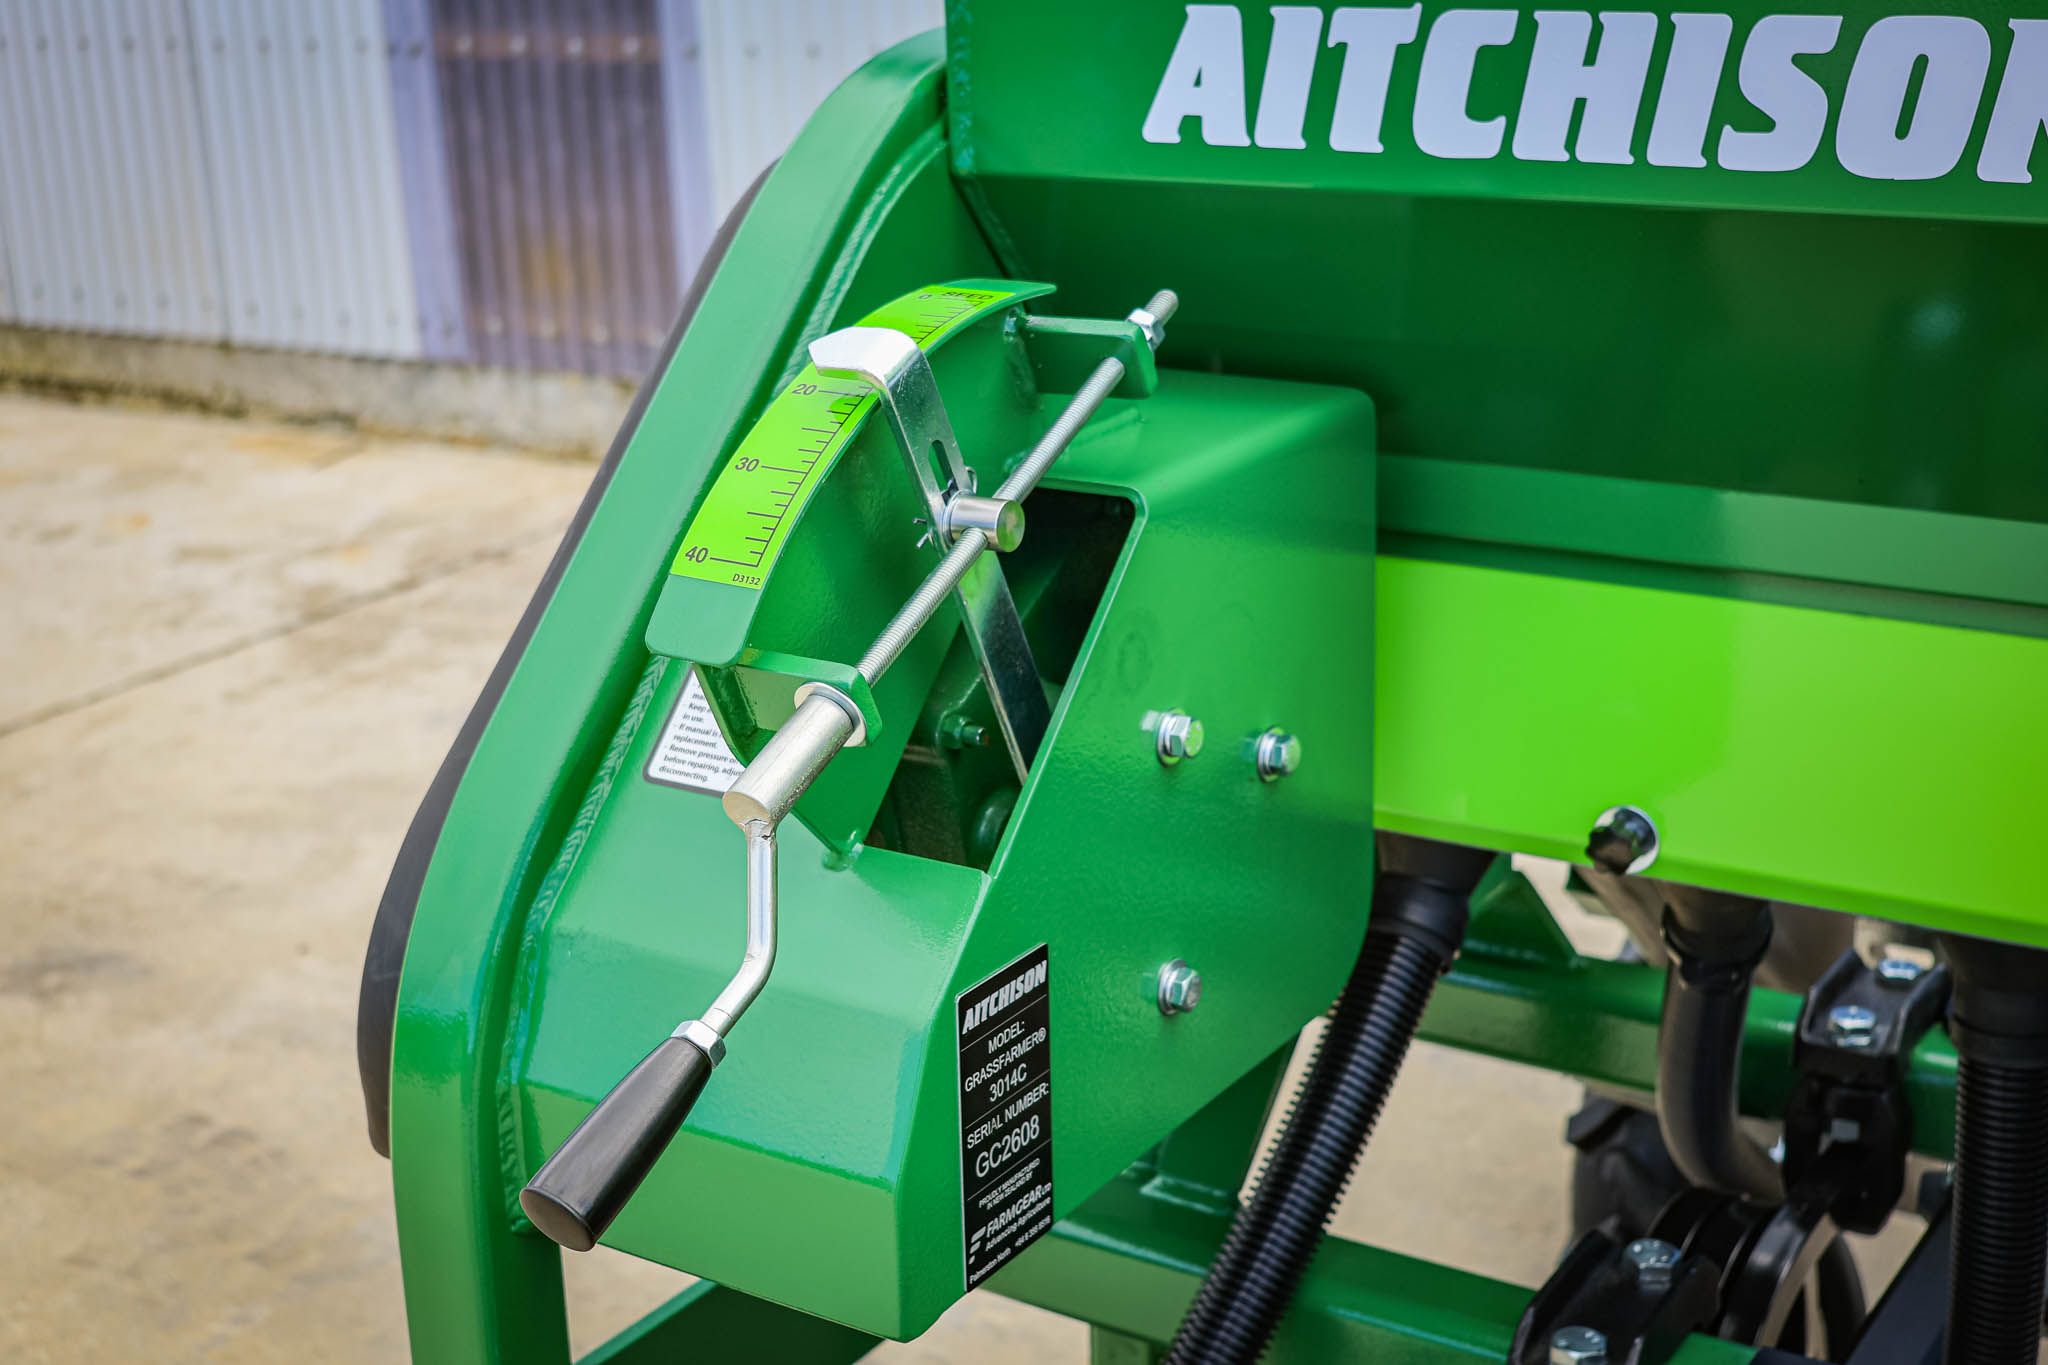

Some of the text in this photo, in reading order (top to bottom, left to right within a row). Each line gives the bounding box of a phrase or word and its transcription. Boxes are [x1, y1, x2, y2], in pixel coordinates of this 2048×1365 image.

[941, 291, 994, 300] SEED
[792, 384, 817, 395] 20
[735, 457, 759, 472] 30
[685, 546, 709, 563] 40
[732, 573, 761, 586] D3132
[688, 702, 706, 713] Keep
[685, 726, 712, 736] manual
[663, 755, 687, 765] before
[669, 744, 697, 756] Remove
[697, 751, 729, 762] pressure
[962, 960, 1047, 1035] AITCHISON
[988, 1021, 1025, 1054] MODEL:
[989, 1063, 1027, 1102] 3014C
[967, 1082, 1049, 1149] SERIAL NUMBER:
[976, 1114, 1040, 1178] GC2608
[979, 1158, 1040, 1208] PROUDLY MANUFACTURED
[993, 1193, 1005, 1206] NEW
[1004, 1176, 1027, 1197] ZEALAND
[986, 1185, 1042, 1238] FARMGEAR
[985, 1221, 1018, 1252] Advancing
[1017, 1196, 1052, 1227] Agriculture
